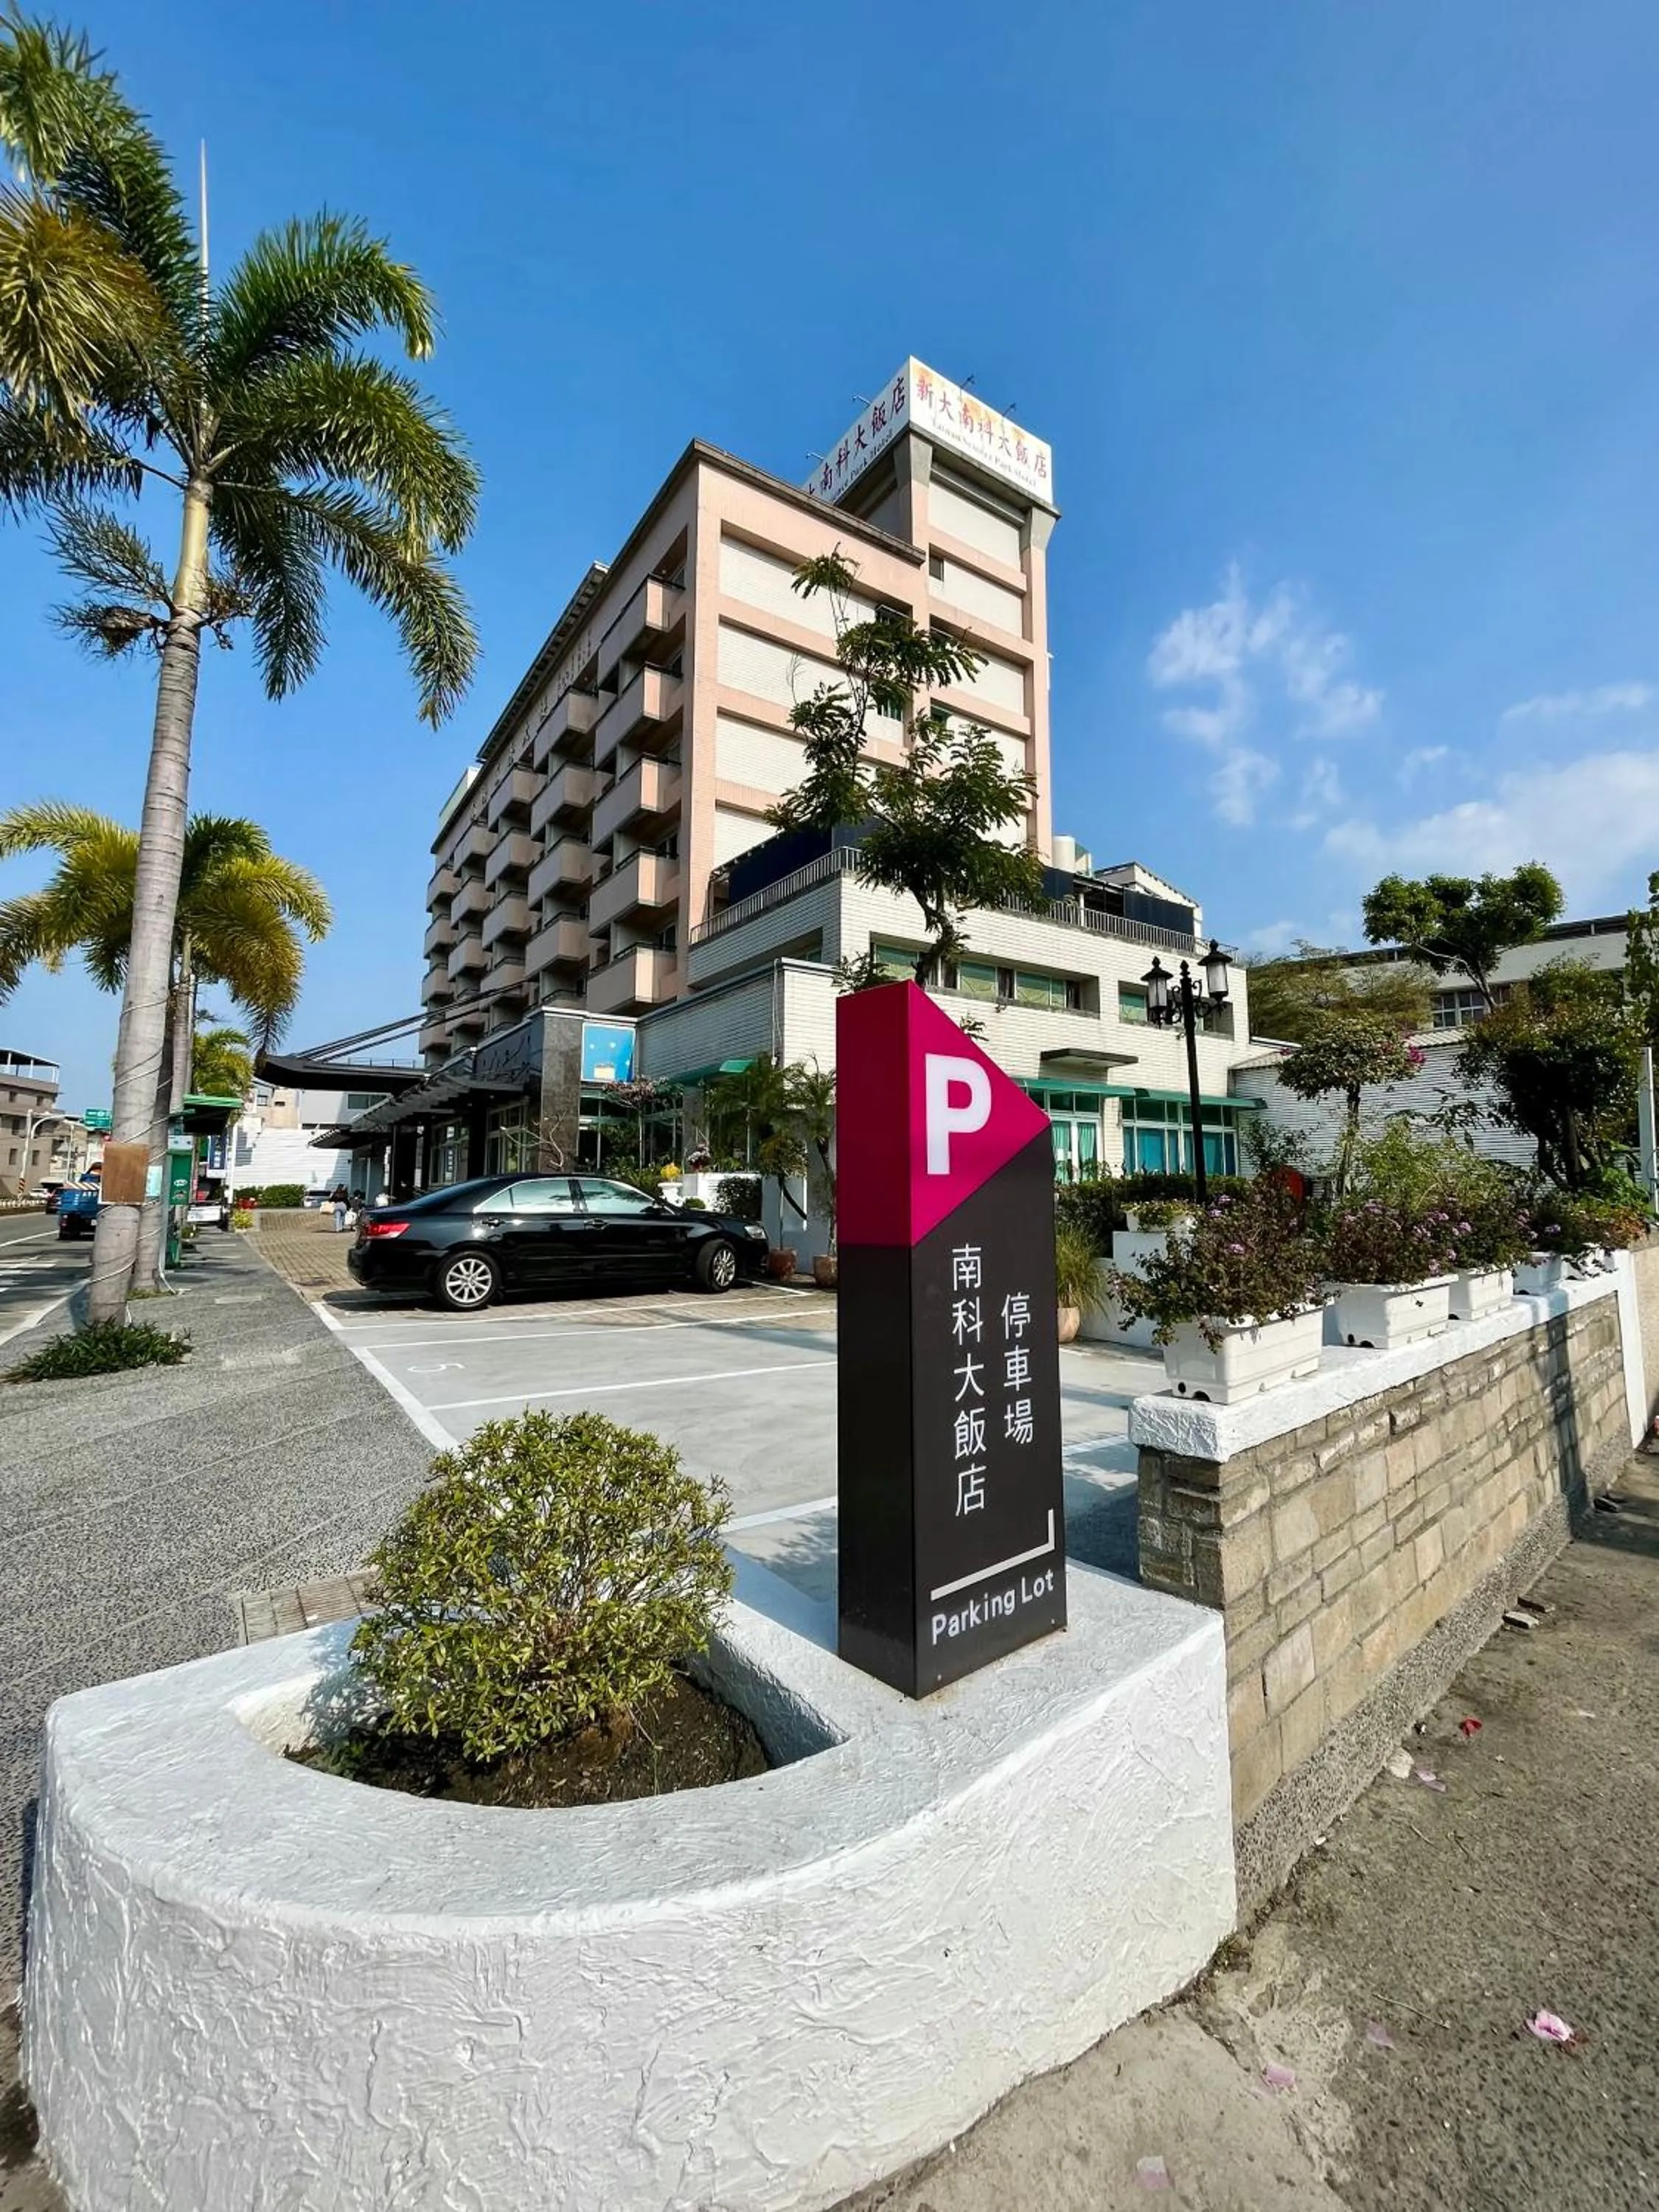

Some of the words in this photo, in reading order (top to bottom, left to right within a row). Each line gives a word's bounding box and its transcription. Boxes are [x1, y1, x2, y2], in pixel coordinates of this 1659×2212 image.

[925, 1053, 992, 1175] P
[952, 1243, 987, 1517] 南科大飯店
[1001, 1292, 1033, 1444] 停車場
[932, 1592, 1015, 1646] Parking
[1021, 1568, 1054, 1604] Lot
